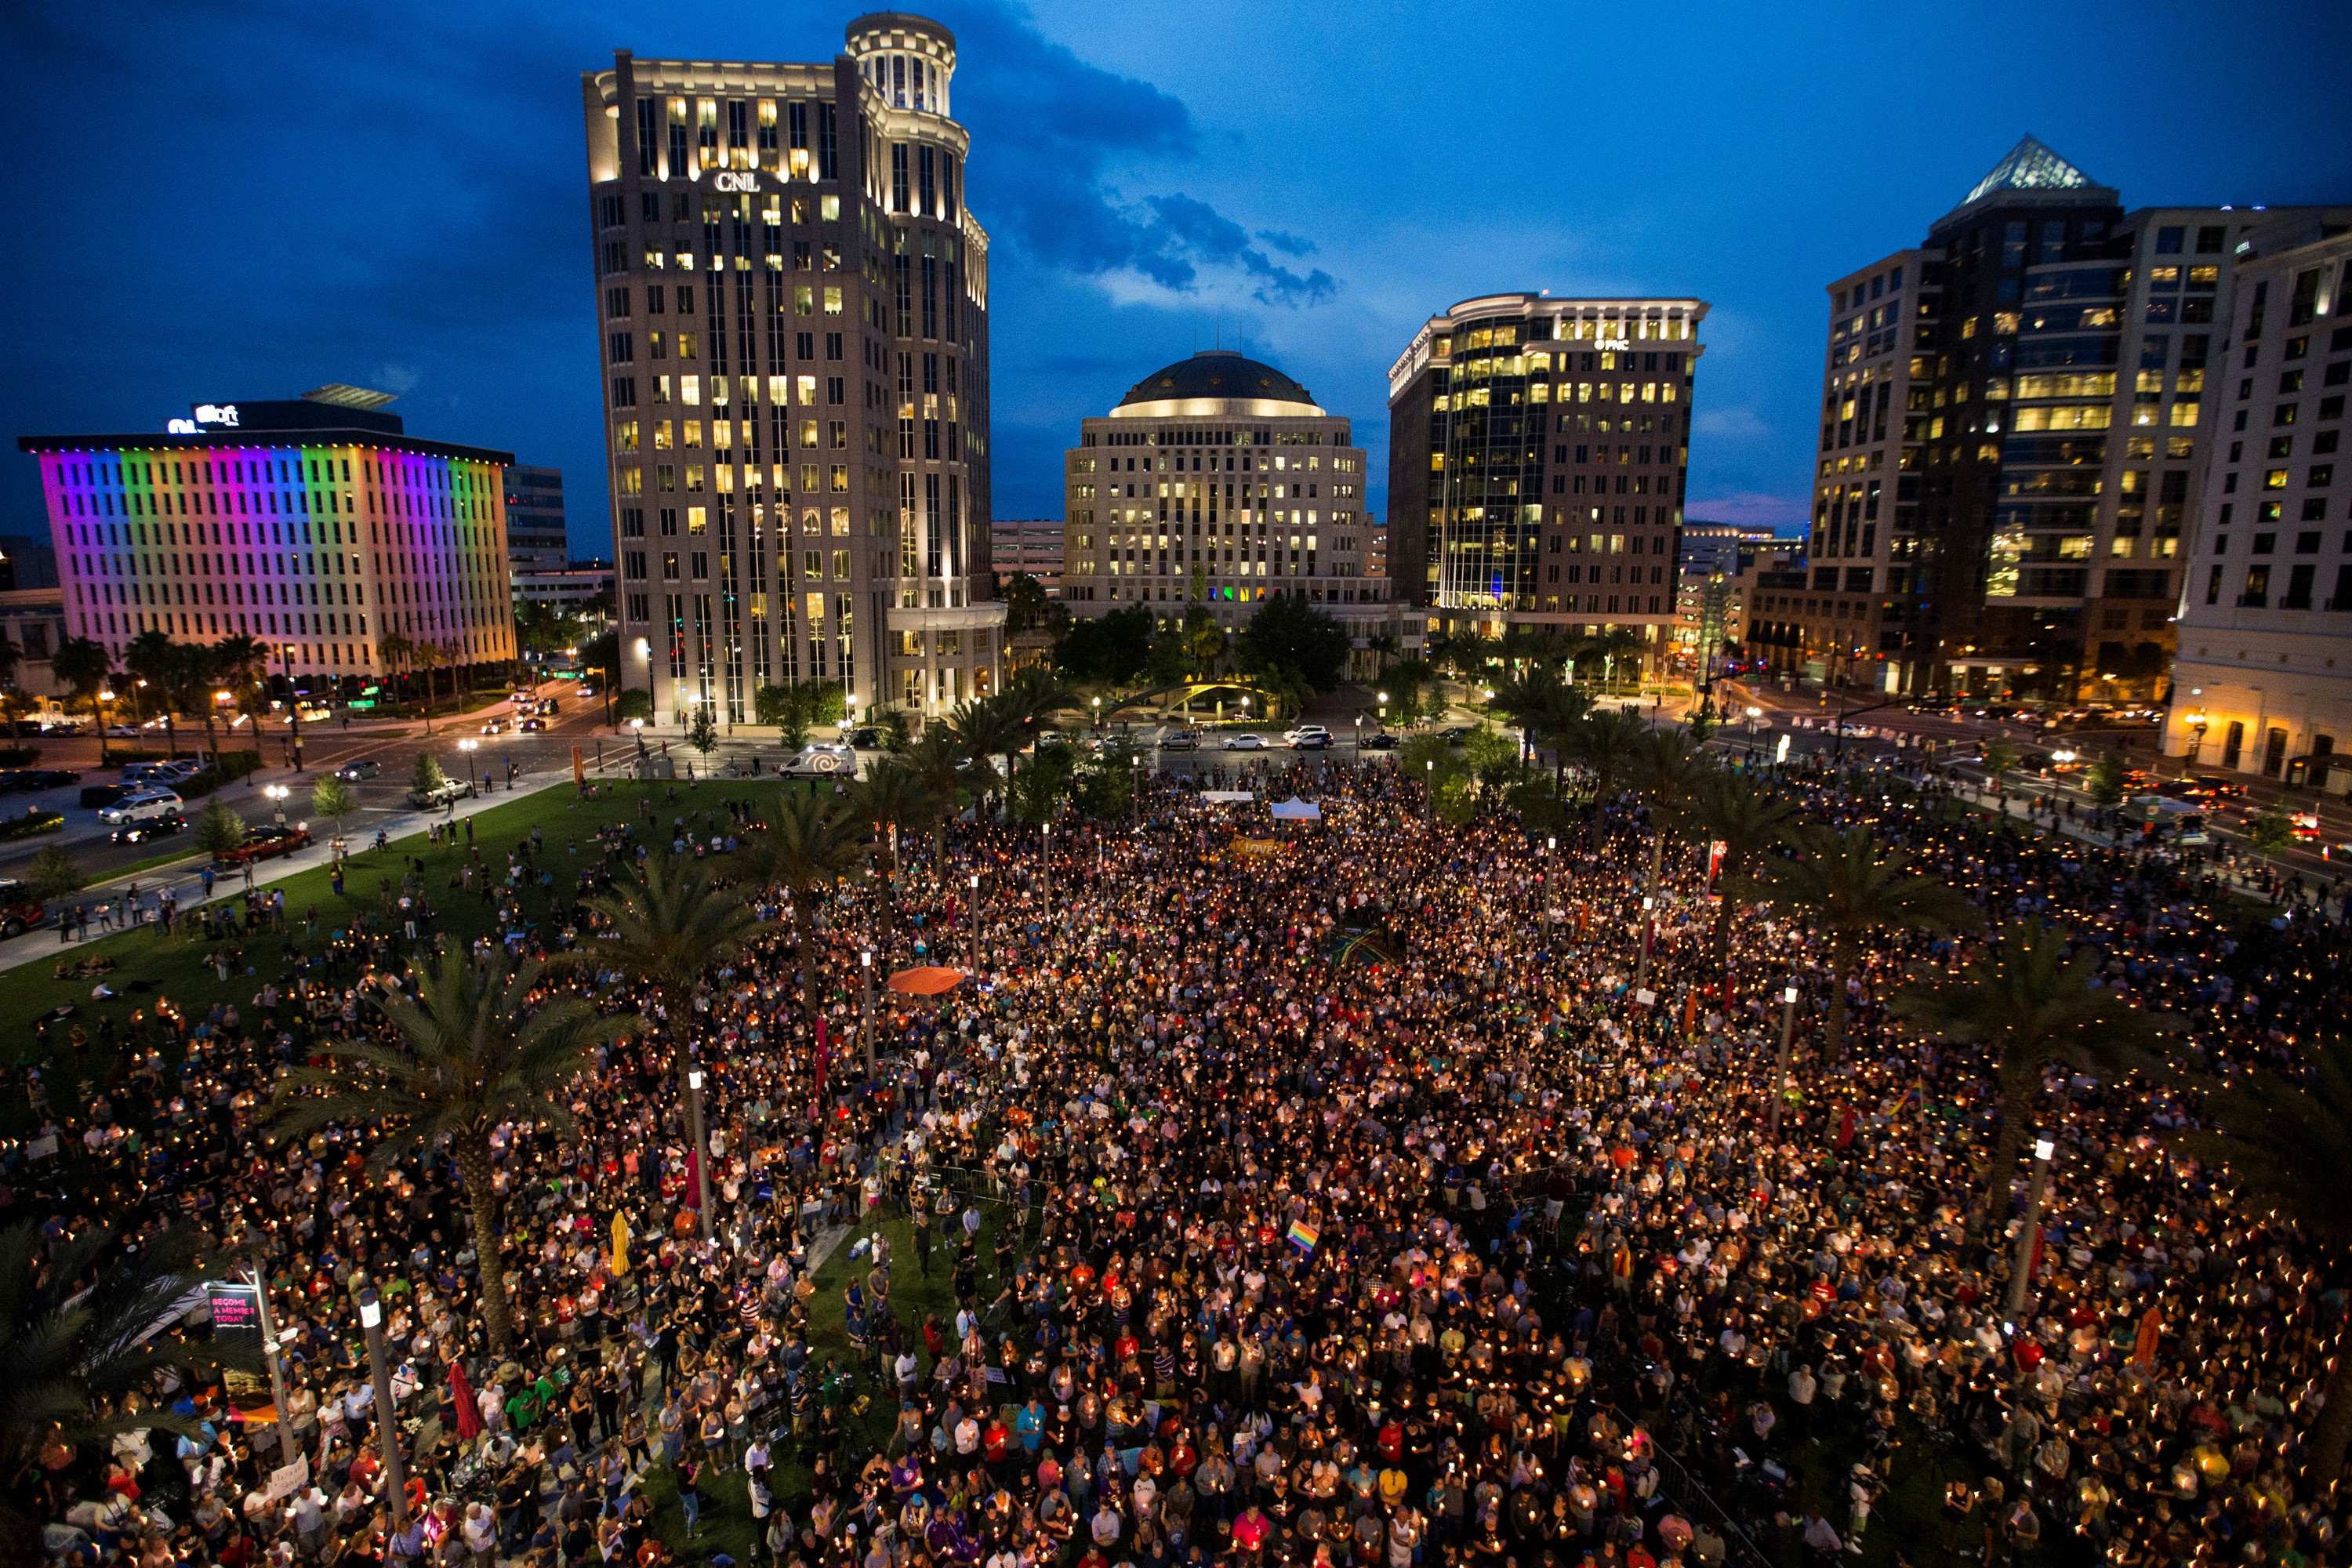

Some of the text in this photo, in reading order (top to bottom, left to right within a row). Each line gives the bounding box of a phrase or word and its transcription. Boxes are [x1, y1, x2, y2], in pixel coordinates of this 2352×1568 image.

[715, 172, 760, 193] CNL
[1605, 339, 1629, 350] PNC
[1245, 843, 1273, 855] LOVE
